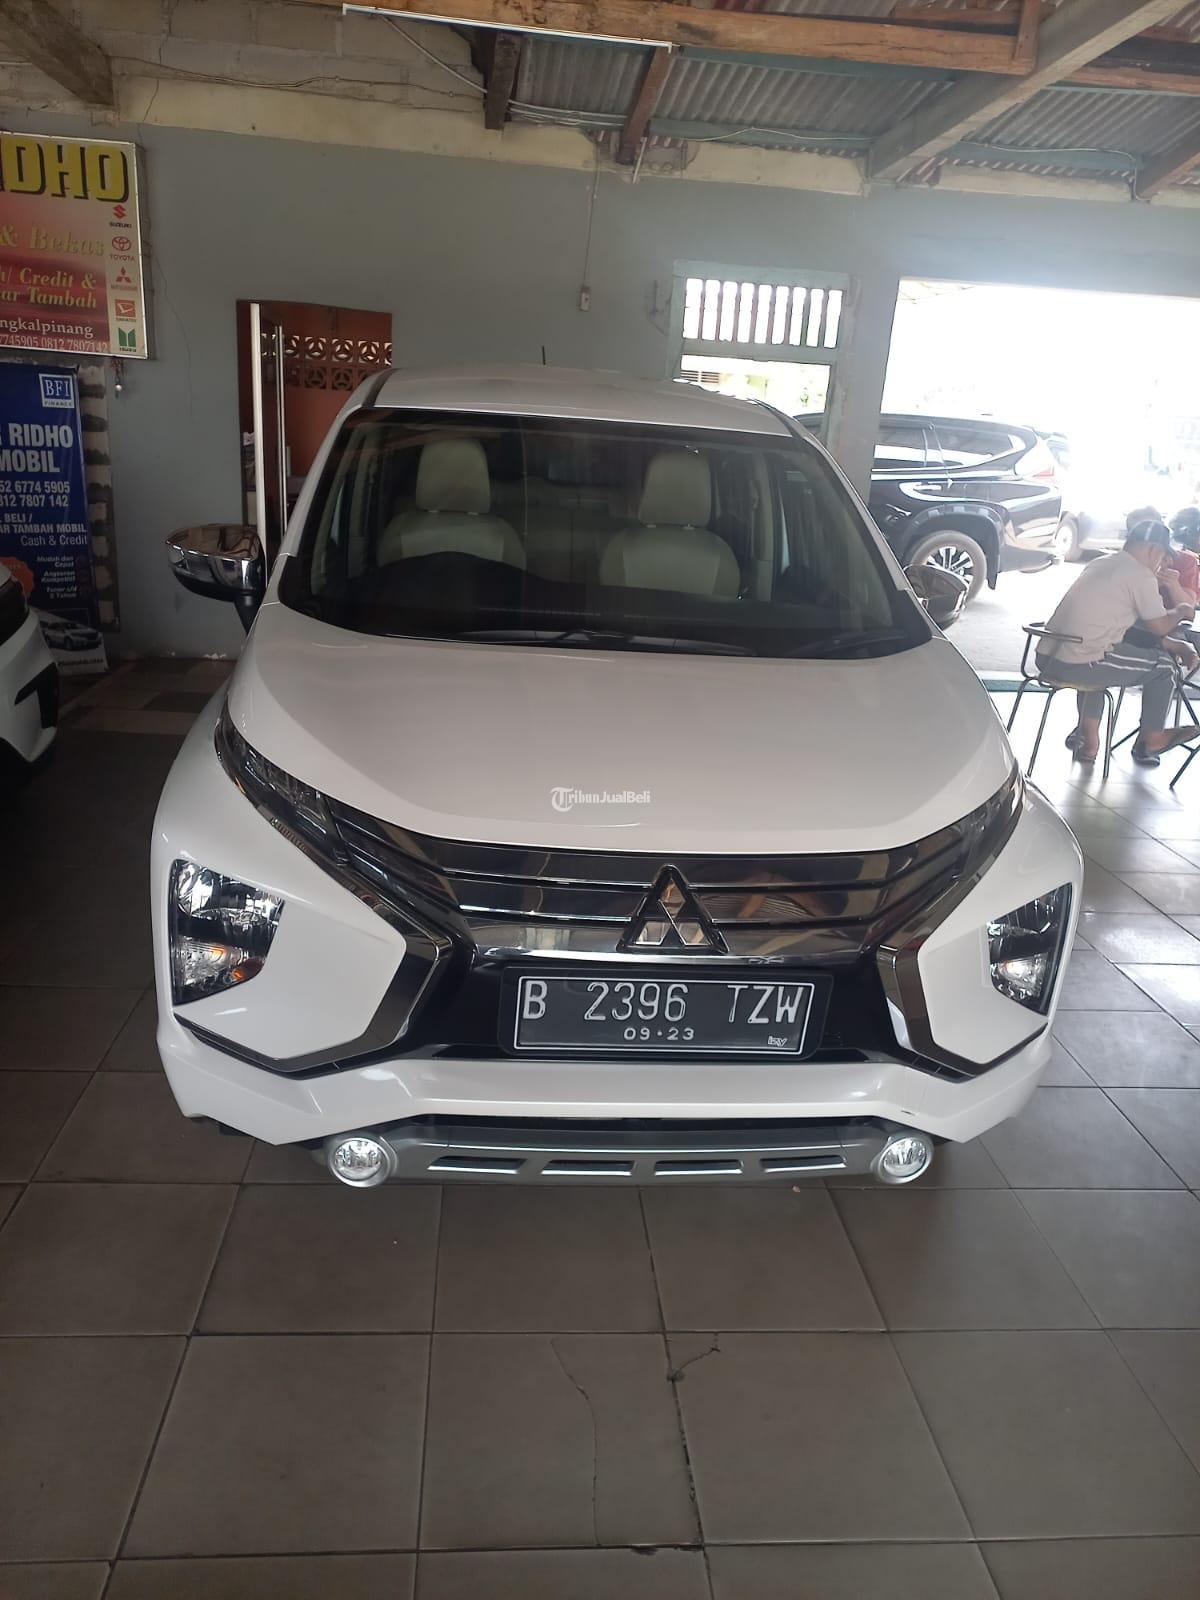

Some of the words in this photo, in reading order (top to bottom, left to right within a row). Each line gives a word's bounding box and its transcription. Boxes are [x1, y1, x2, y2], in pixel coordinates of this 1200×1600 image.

[109, 254, 136, 262] TOYOTA
[19, 266, 74, 289] Credit
[80, 272, 97, 290] &
[27, 286, 97, 310] Tambah
[44, 379, 71, 397] BFI
[8, 422, 74, 448] RIDHO
[14, 481, 42, 494] 6774
[44, 481, 71, 494] 5905
[18, 494, 46, 508] 7807
[49, 495, 69, 507] 142
[4, 513, 26, 523] BELI
[13, 524, 54, 534] TAMBAH
[56, 523, 87, 533] MOBIL
[21, 535, 46, 546] Cash
[48, 535, 57, 546] &
[59, 534, 88, 545] Credit
[522, 980, 548, 1020] B
[584, 981, 689, 1022] 2396
[727, 985, 804, 1024] TZW
